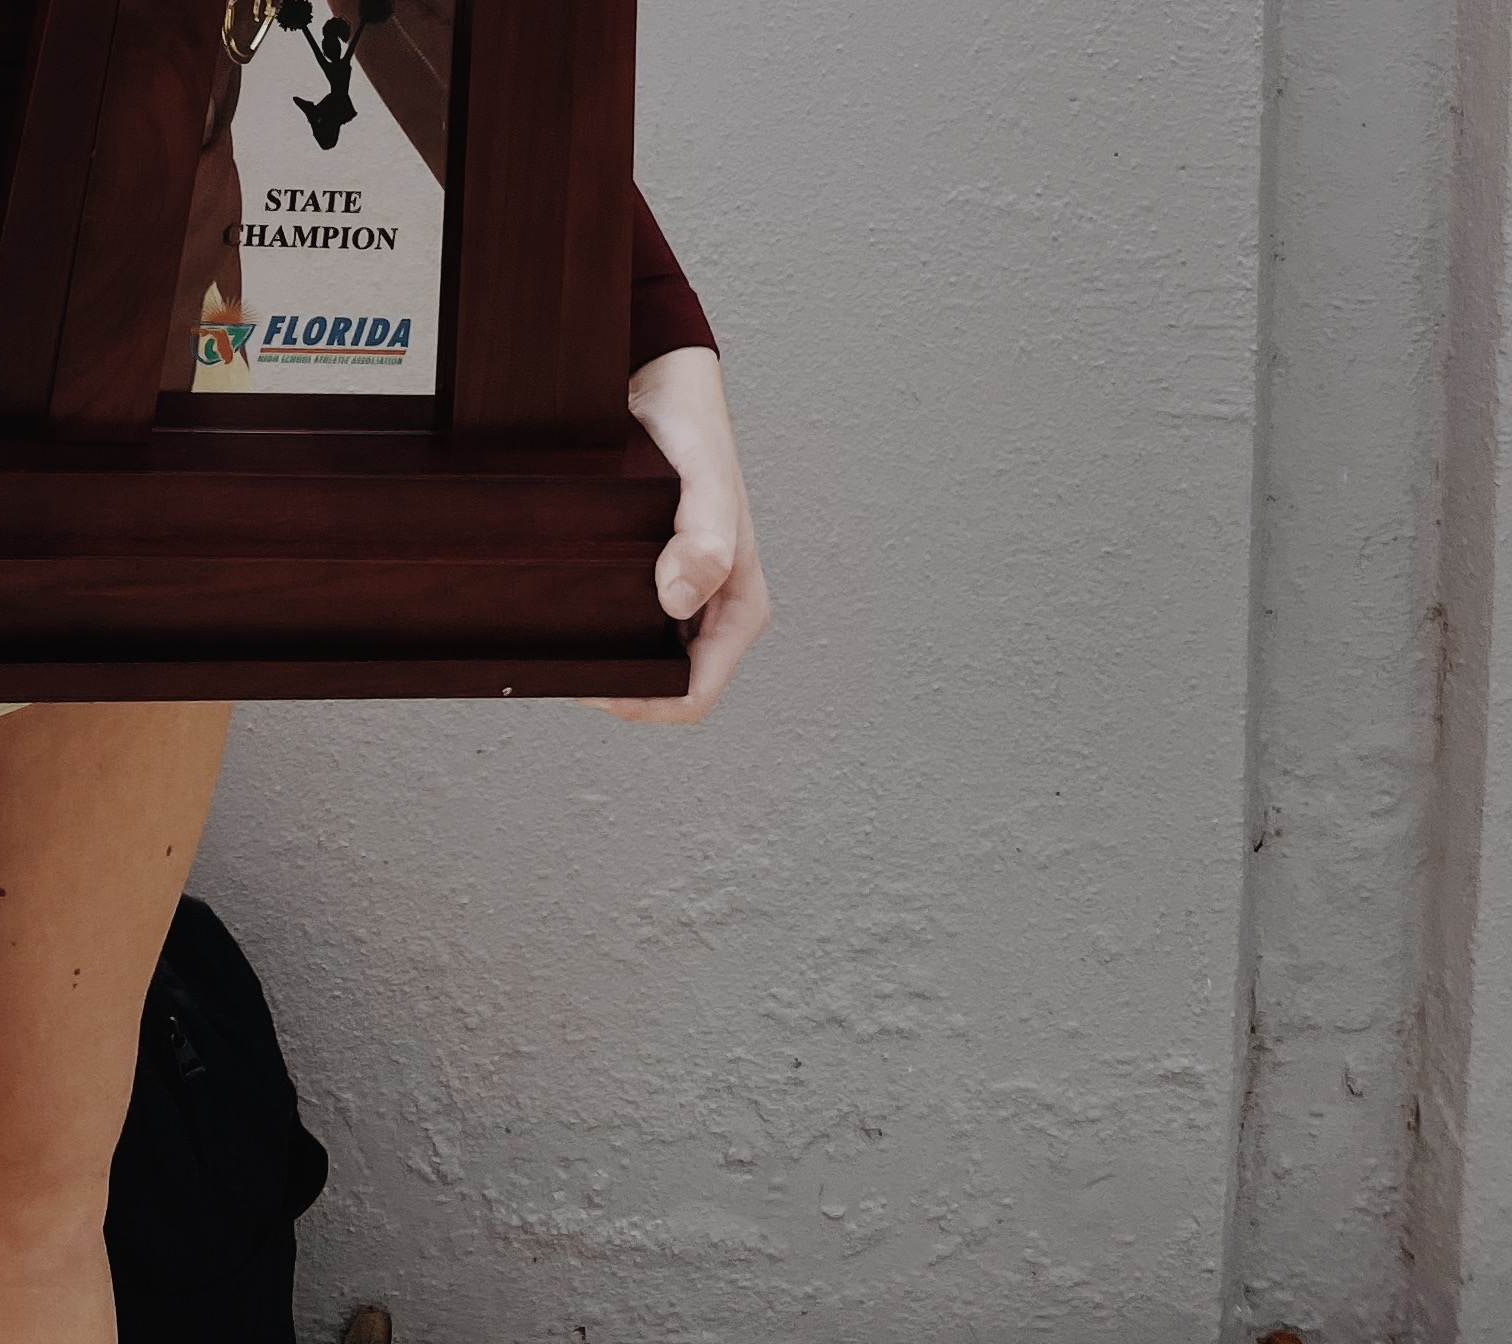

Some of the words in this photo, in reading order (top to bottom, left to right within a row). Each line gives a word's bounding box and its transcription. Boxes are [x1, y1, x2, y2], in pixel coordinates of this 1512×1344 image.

[265, 188, 362, 214] STATE
[222, 222, 399, 250] CHAMPION
[262, 315, 412, 348] FLORIDA
